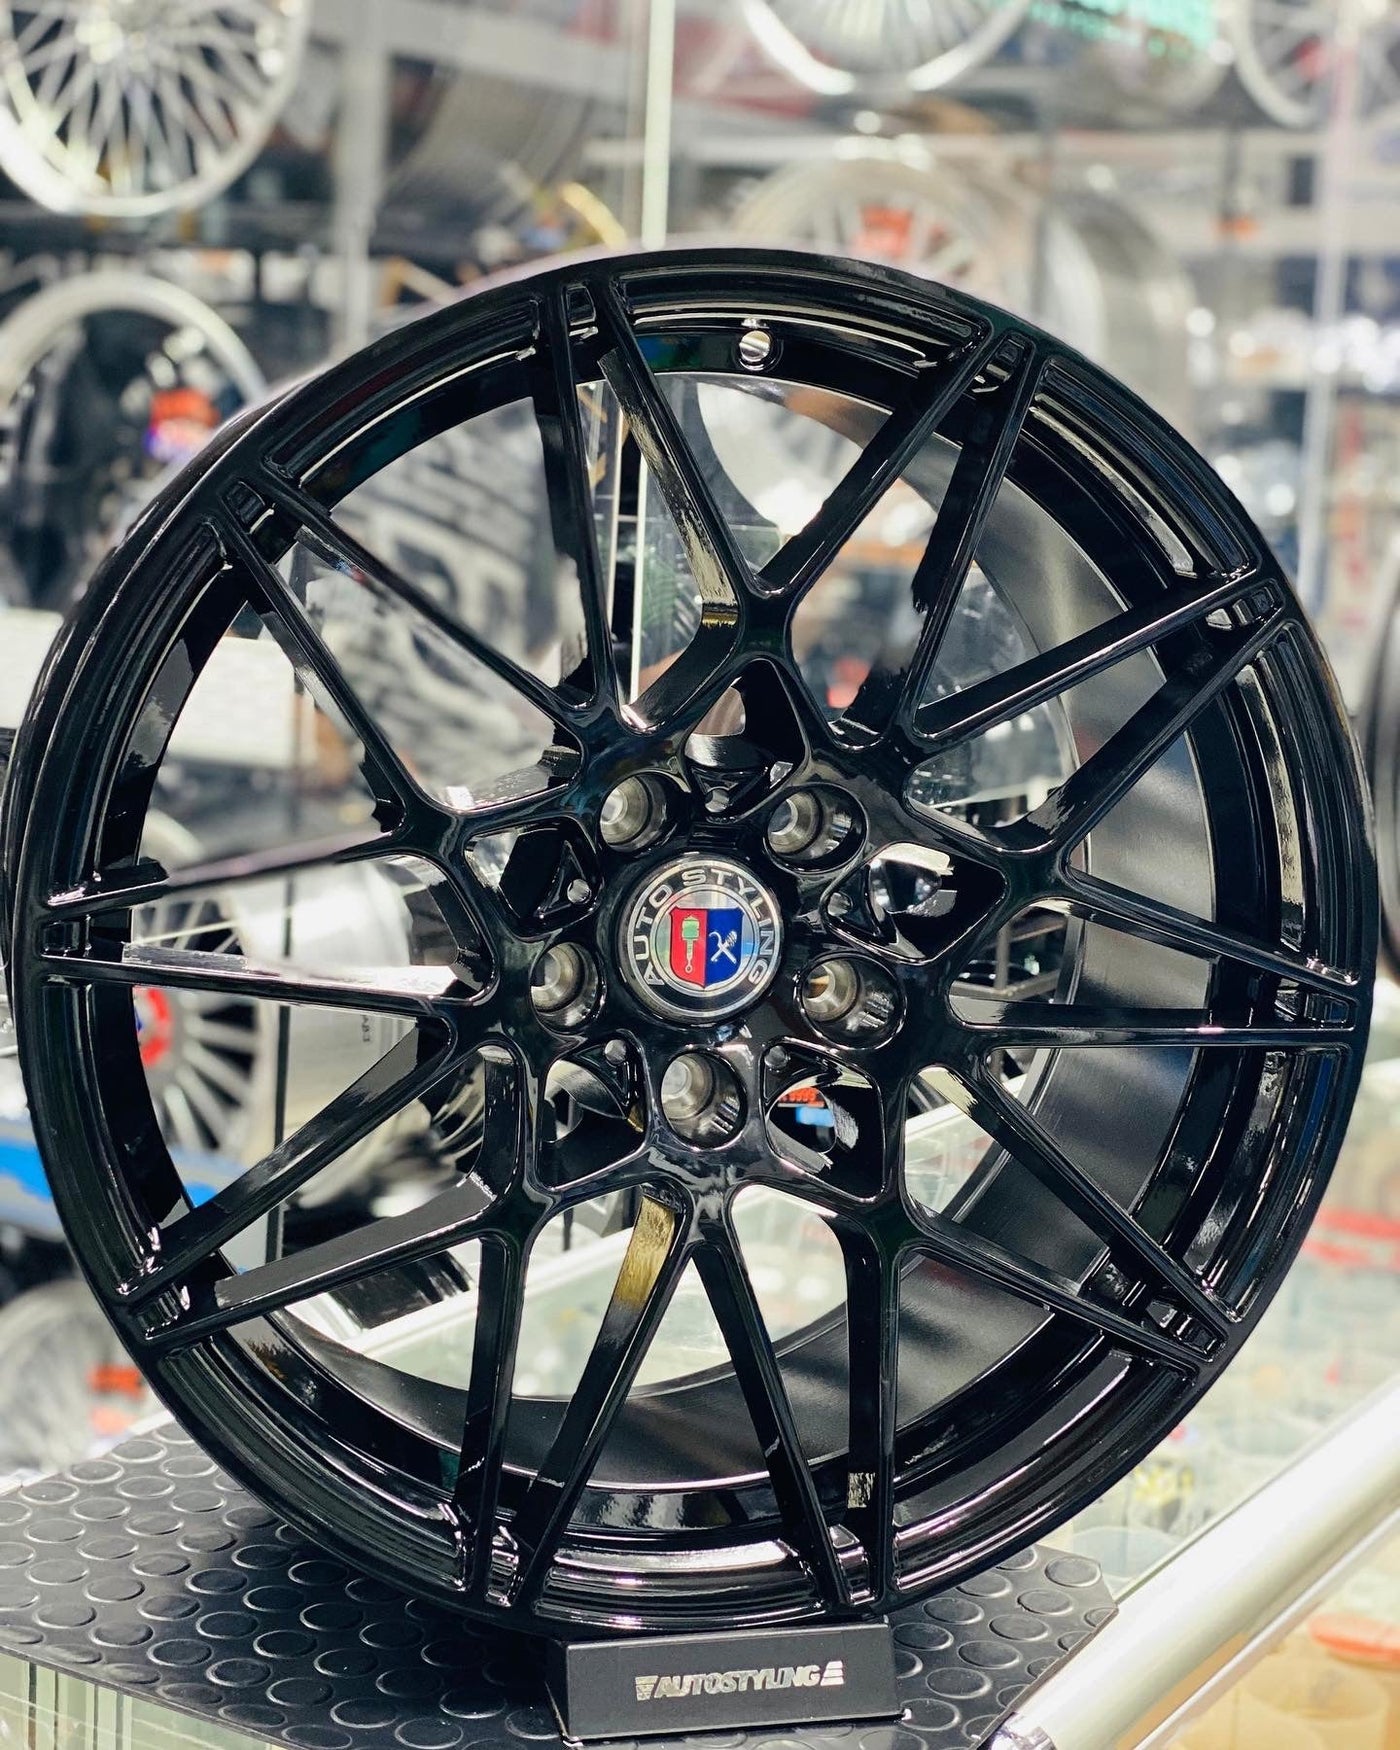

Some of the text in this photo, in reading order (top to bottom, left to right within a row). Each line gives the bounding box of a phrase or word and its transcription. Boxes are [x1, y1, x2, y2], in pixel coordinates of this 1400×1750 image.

[633, 868, 774, 986] AUTO STYLING
[654, 1664, 821, 1698] AUTOSTYLING
